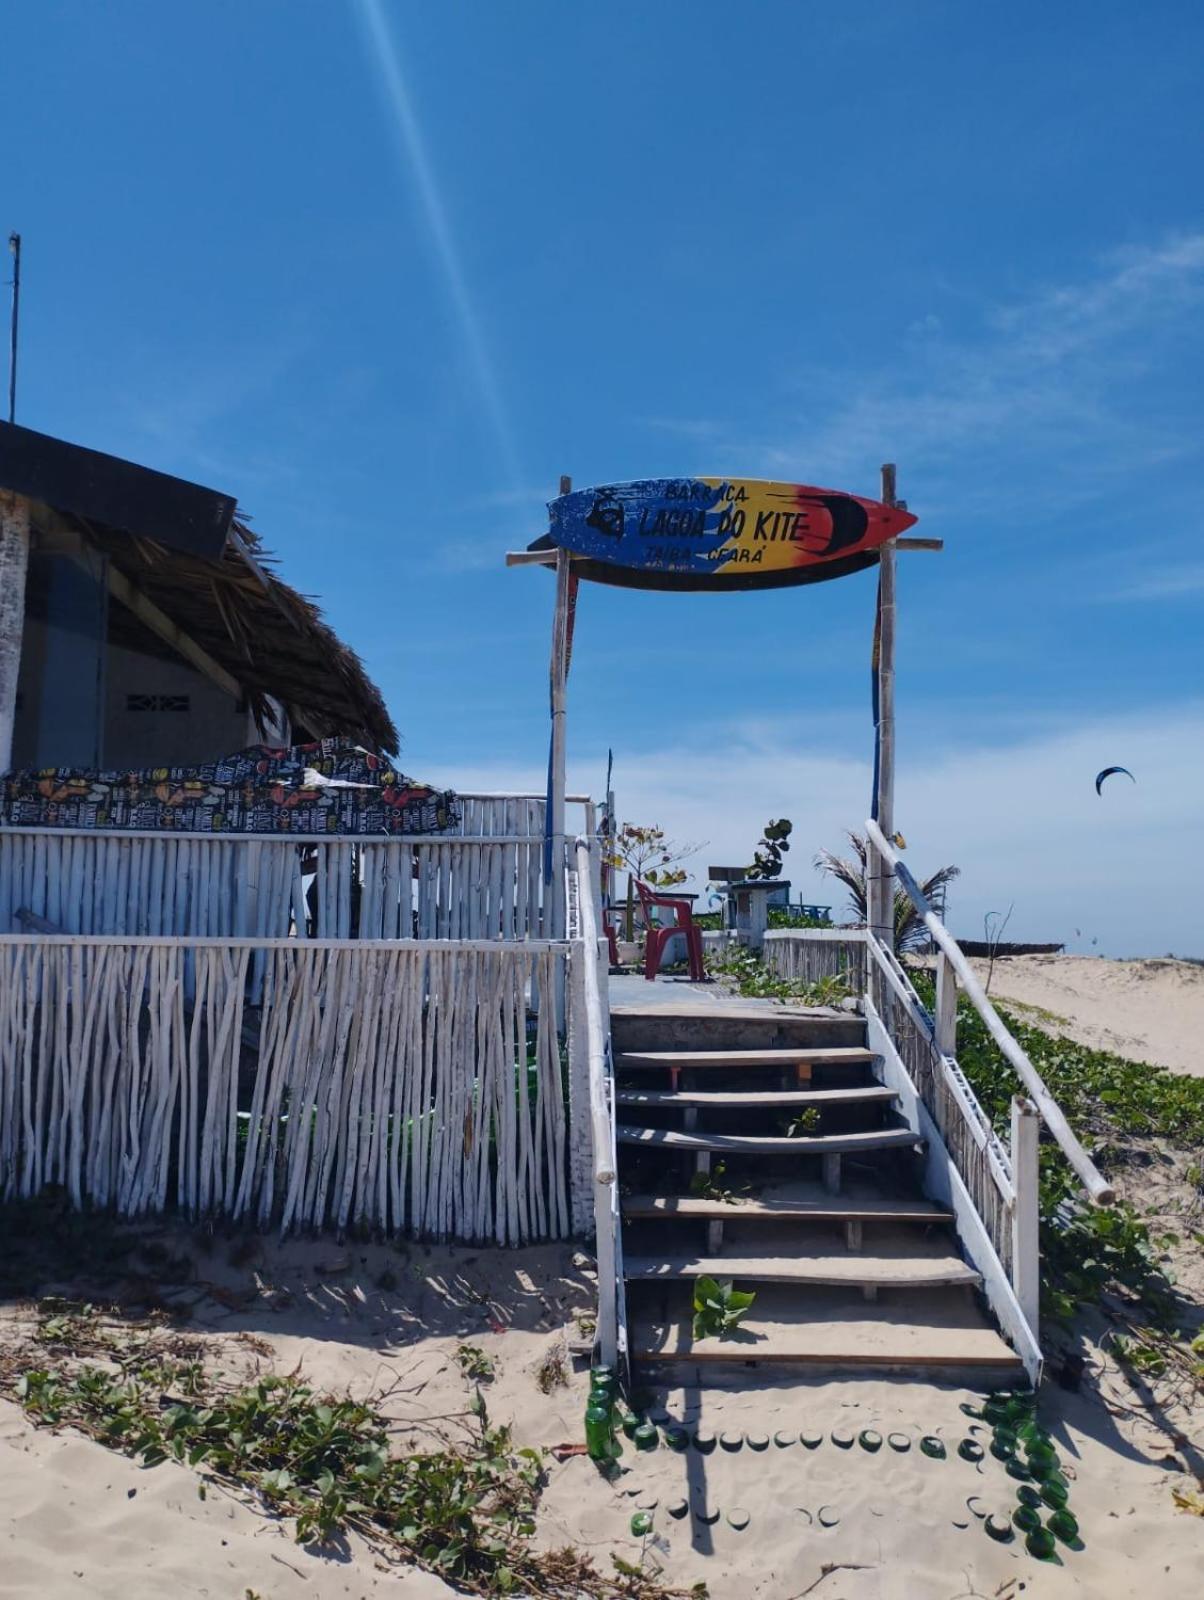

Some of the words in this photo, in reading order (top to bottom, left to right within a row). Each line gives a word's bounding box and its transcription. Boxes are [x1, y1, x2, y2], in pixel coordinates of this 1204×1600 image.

[665, 483, 748, 502] BARRACA
[640, 508, 704, 537] LAGOA
[718, 509, 746, 539] DO
[754, 512, 809, 541] KITE
[708, 545, 767, 563] CEARÁ
